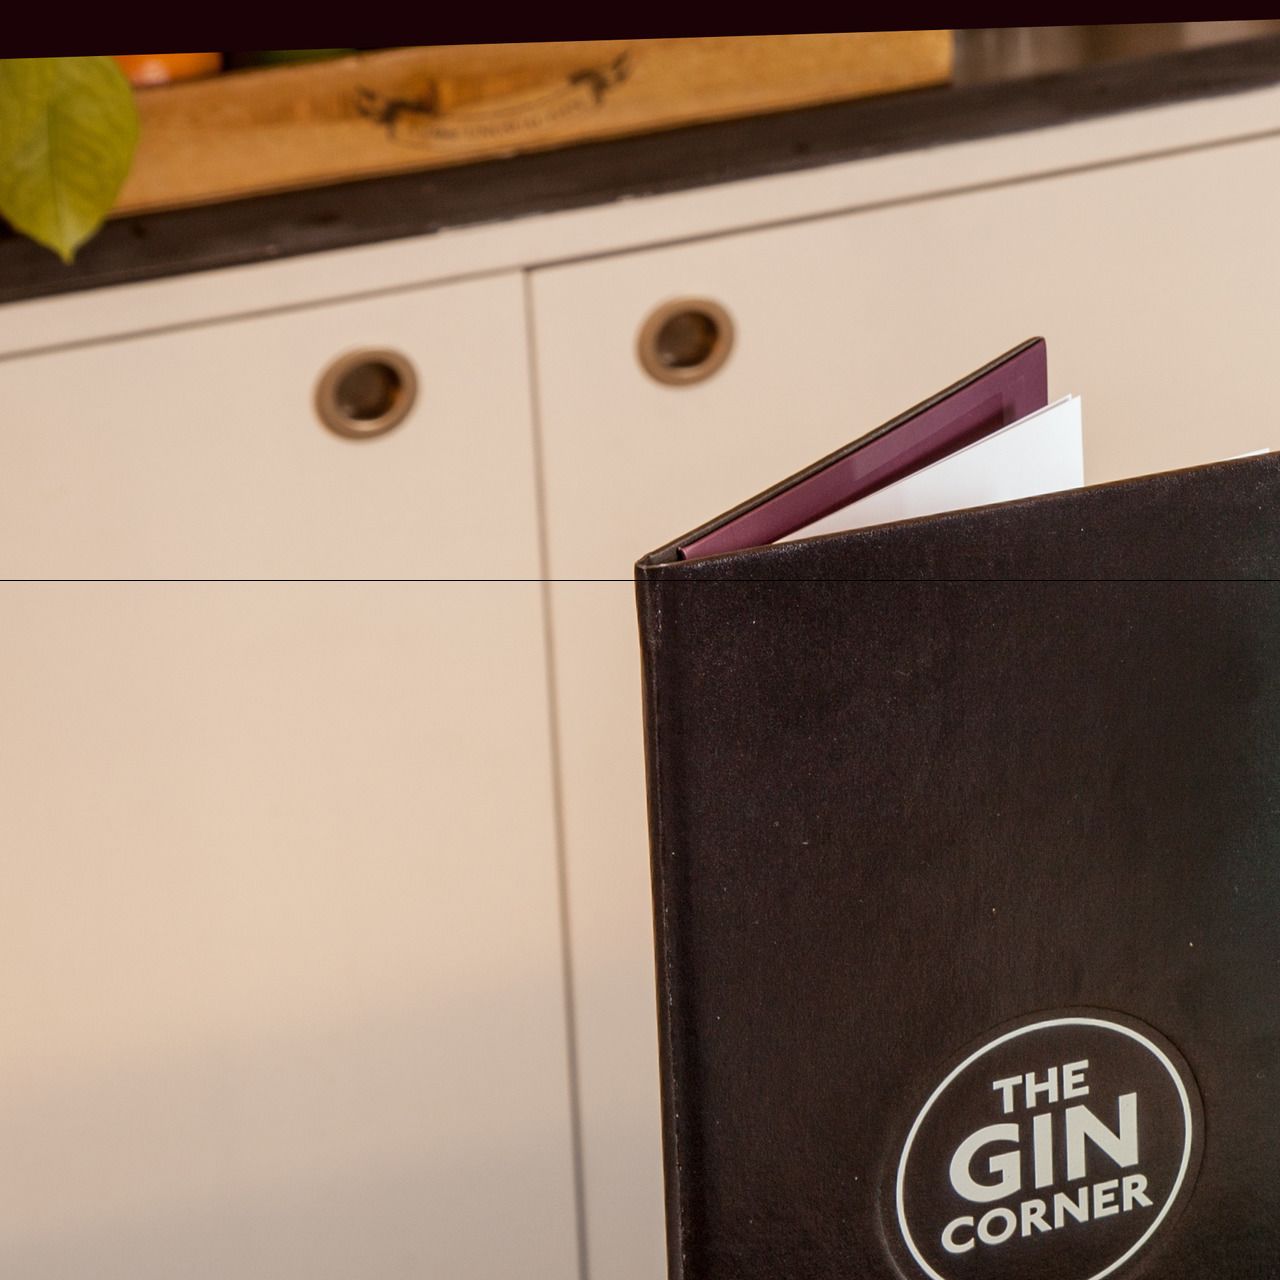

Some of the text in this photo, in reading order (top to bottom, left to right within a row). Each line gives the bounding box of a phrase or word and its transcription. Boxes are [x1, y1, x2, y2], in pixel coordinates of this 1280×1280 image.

[992, 1058, 1090, 1114] THE
[949, 1092, 1139, 1204] GIN
[941, 1173, 1154, 1254] CORNER
